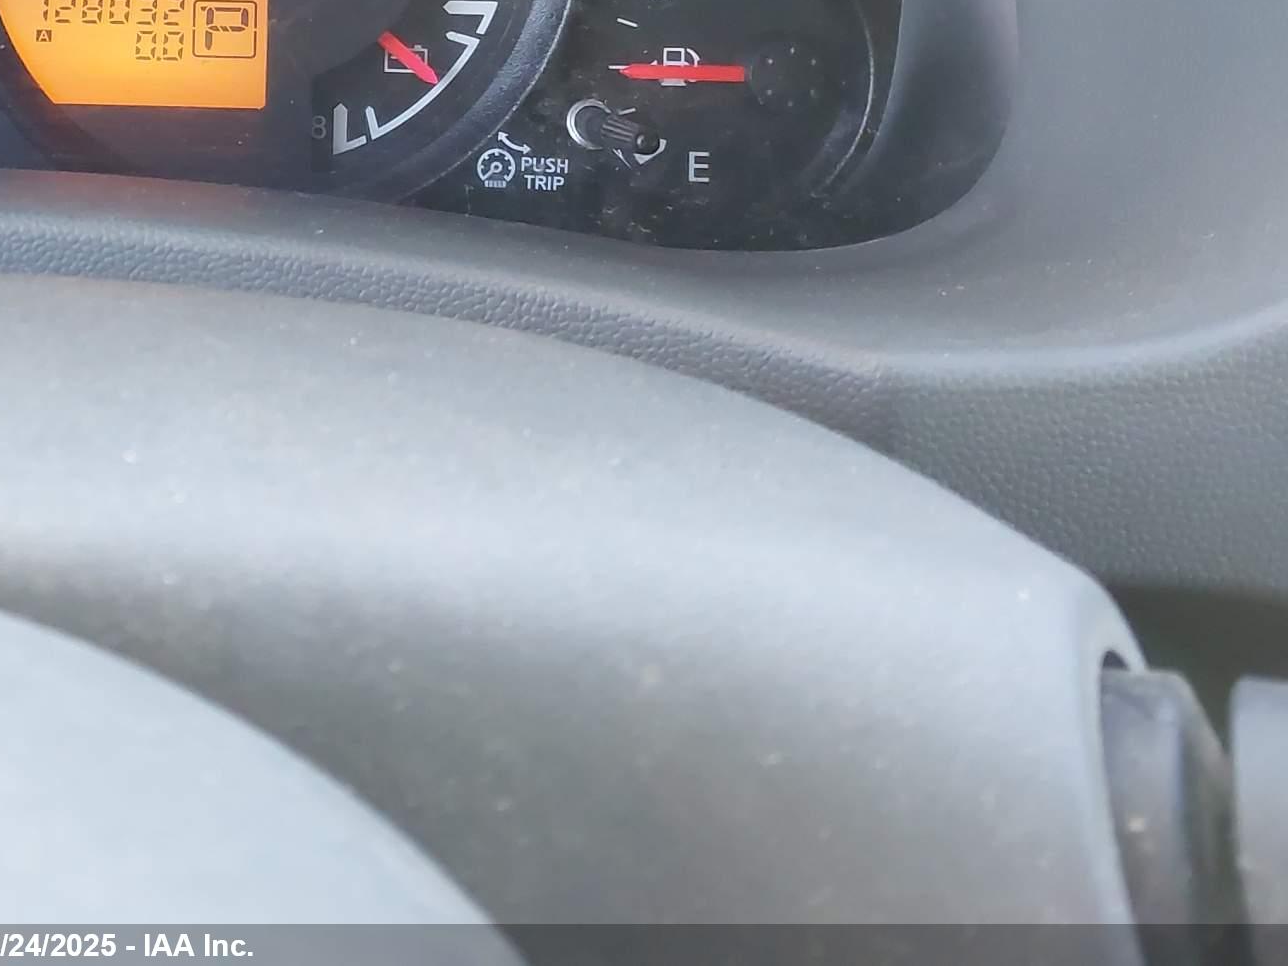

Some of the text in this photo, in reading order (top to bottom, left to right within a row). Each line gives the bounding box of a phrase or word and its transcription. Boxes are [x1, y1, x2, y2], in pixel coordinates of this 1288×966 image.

[36, 30, 52, 42] A
[200, 6, 249, 51] P
[135, 30, 184, 61] 0.0
[311, 115, 327, 139] 8
[521, 156, 569, 174] PUSH
[688, 151, 710, 183] E
[523, 174, 565, 191] TRIP
